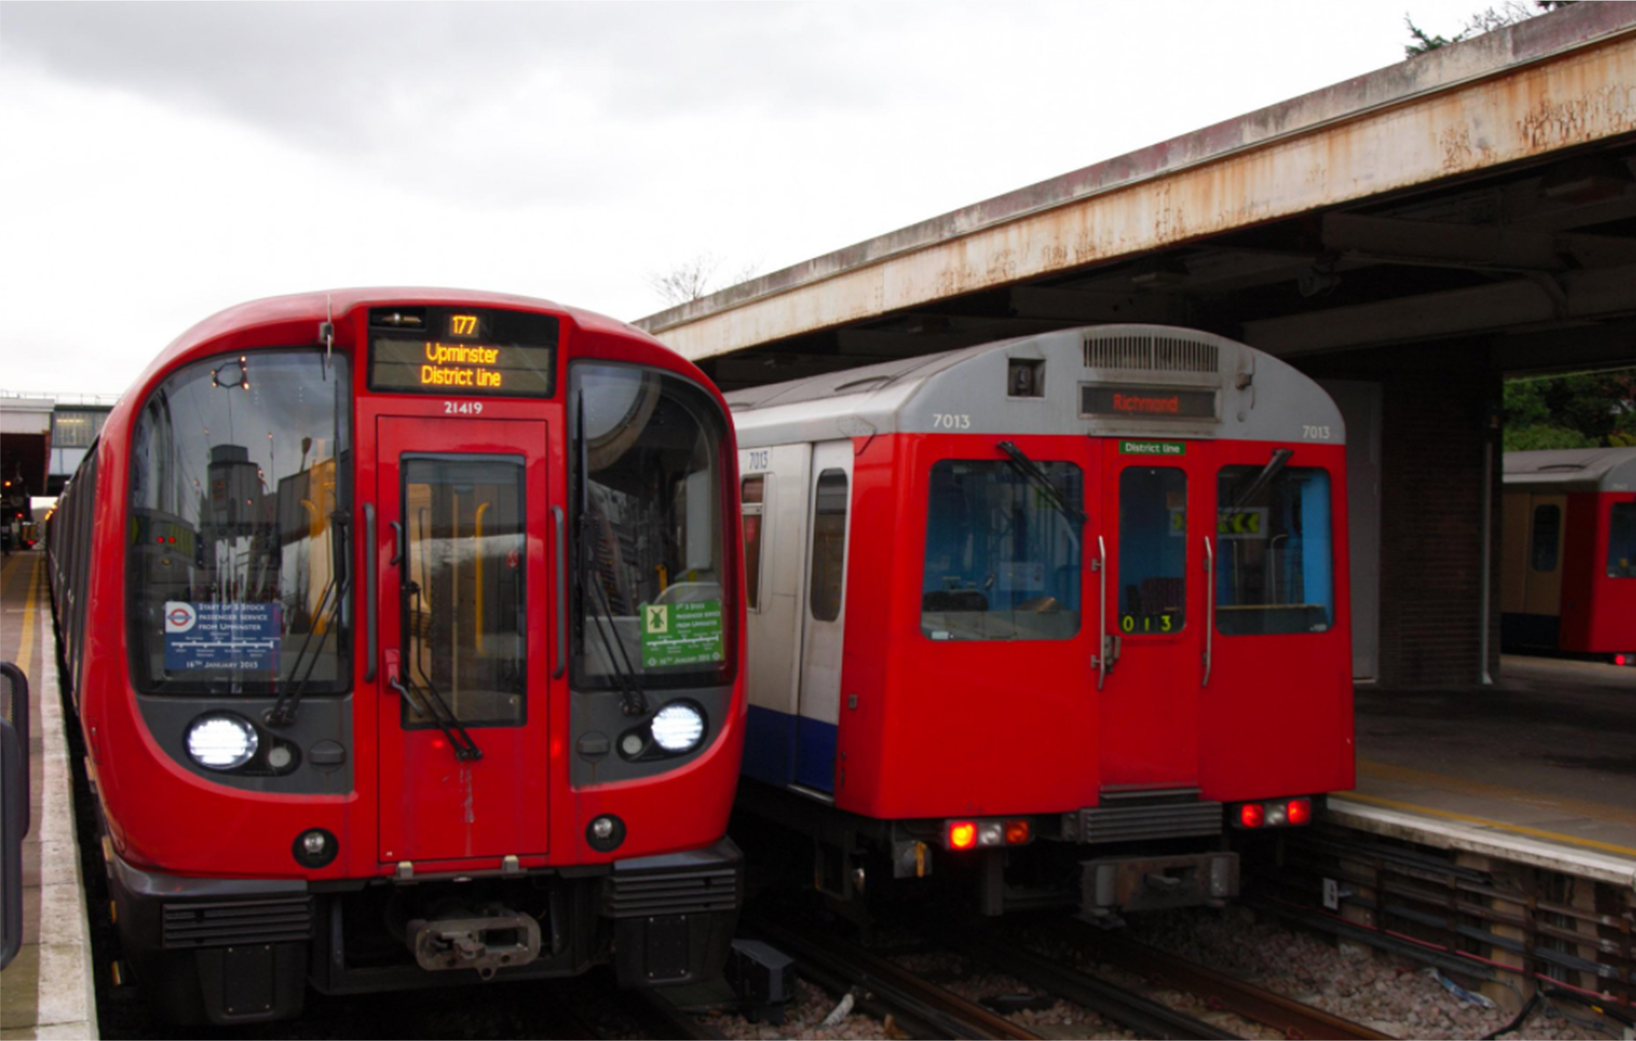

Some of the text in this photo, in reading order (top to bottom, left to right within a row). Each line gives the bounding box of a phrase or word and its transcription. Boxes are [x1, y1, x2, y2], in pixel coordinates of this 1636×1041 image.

[452, 314, 477, 335] 177
[425, 342, 499, 364] Upminster
[421, 365, 502, 387] District line
[443, 401, 483, 415] 21419
[1113, 395, 1178, 413] Richmond
[932, 413, 971, 430] 7013
[1302, 425, 1331, 440] 7013
[1124, 443, 1181, 455] District line
[748, 449, 769, 470] 7013
[204, 660, 237, 669] JANUARY
